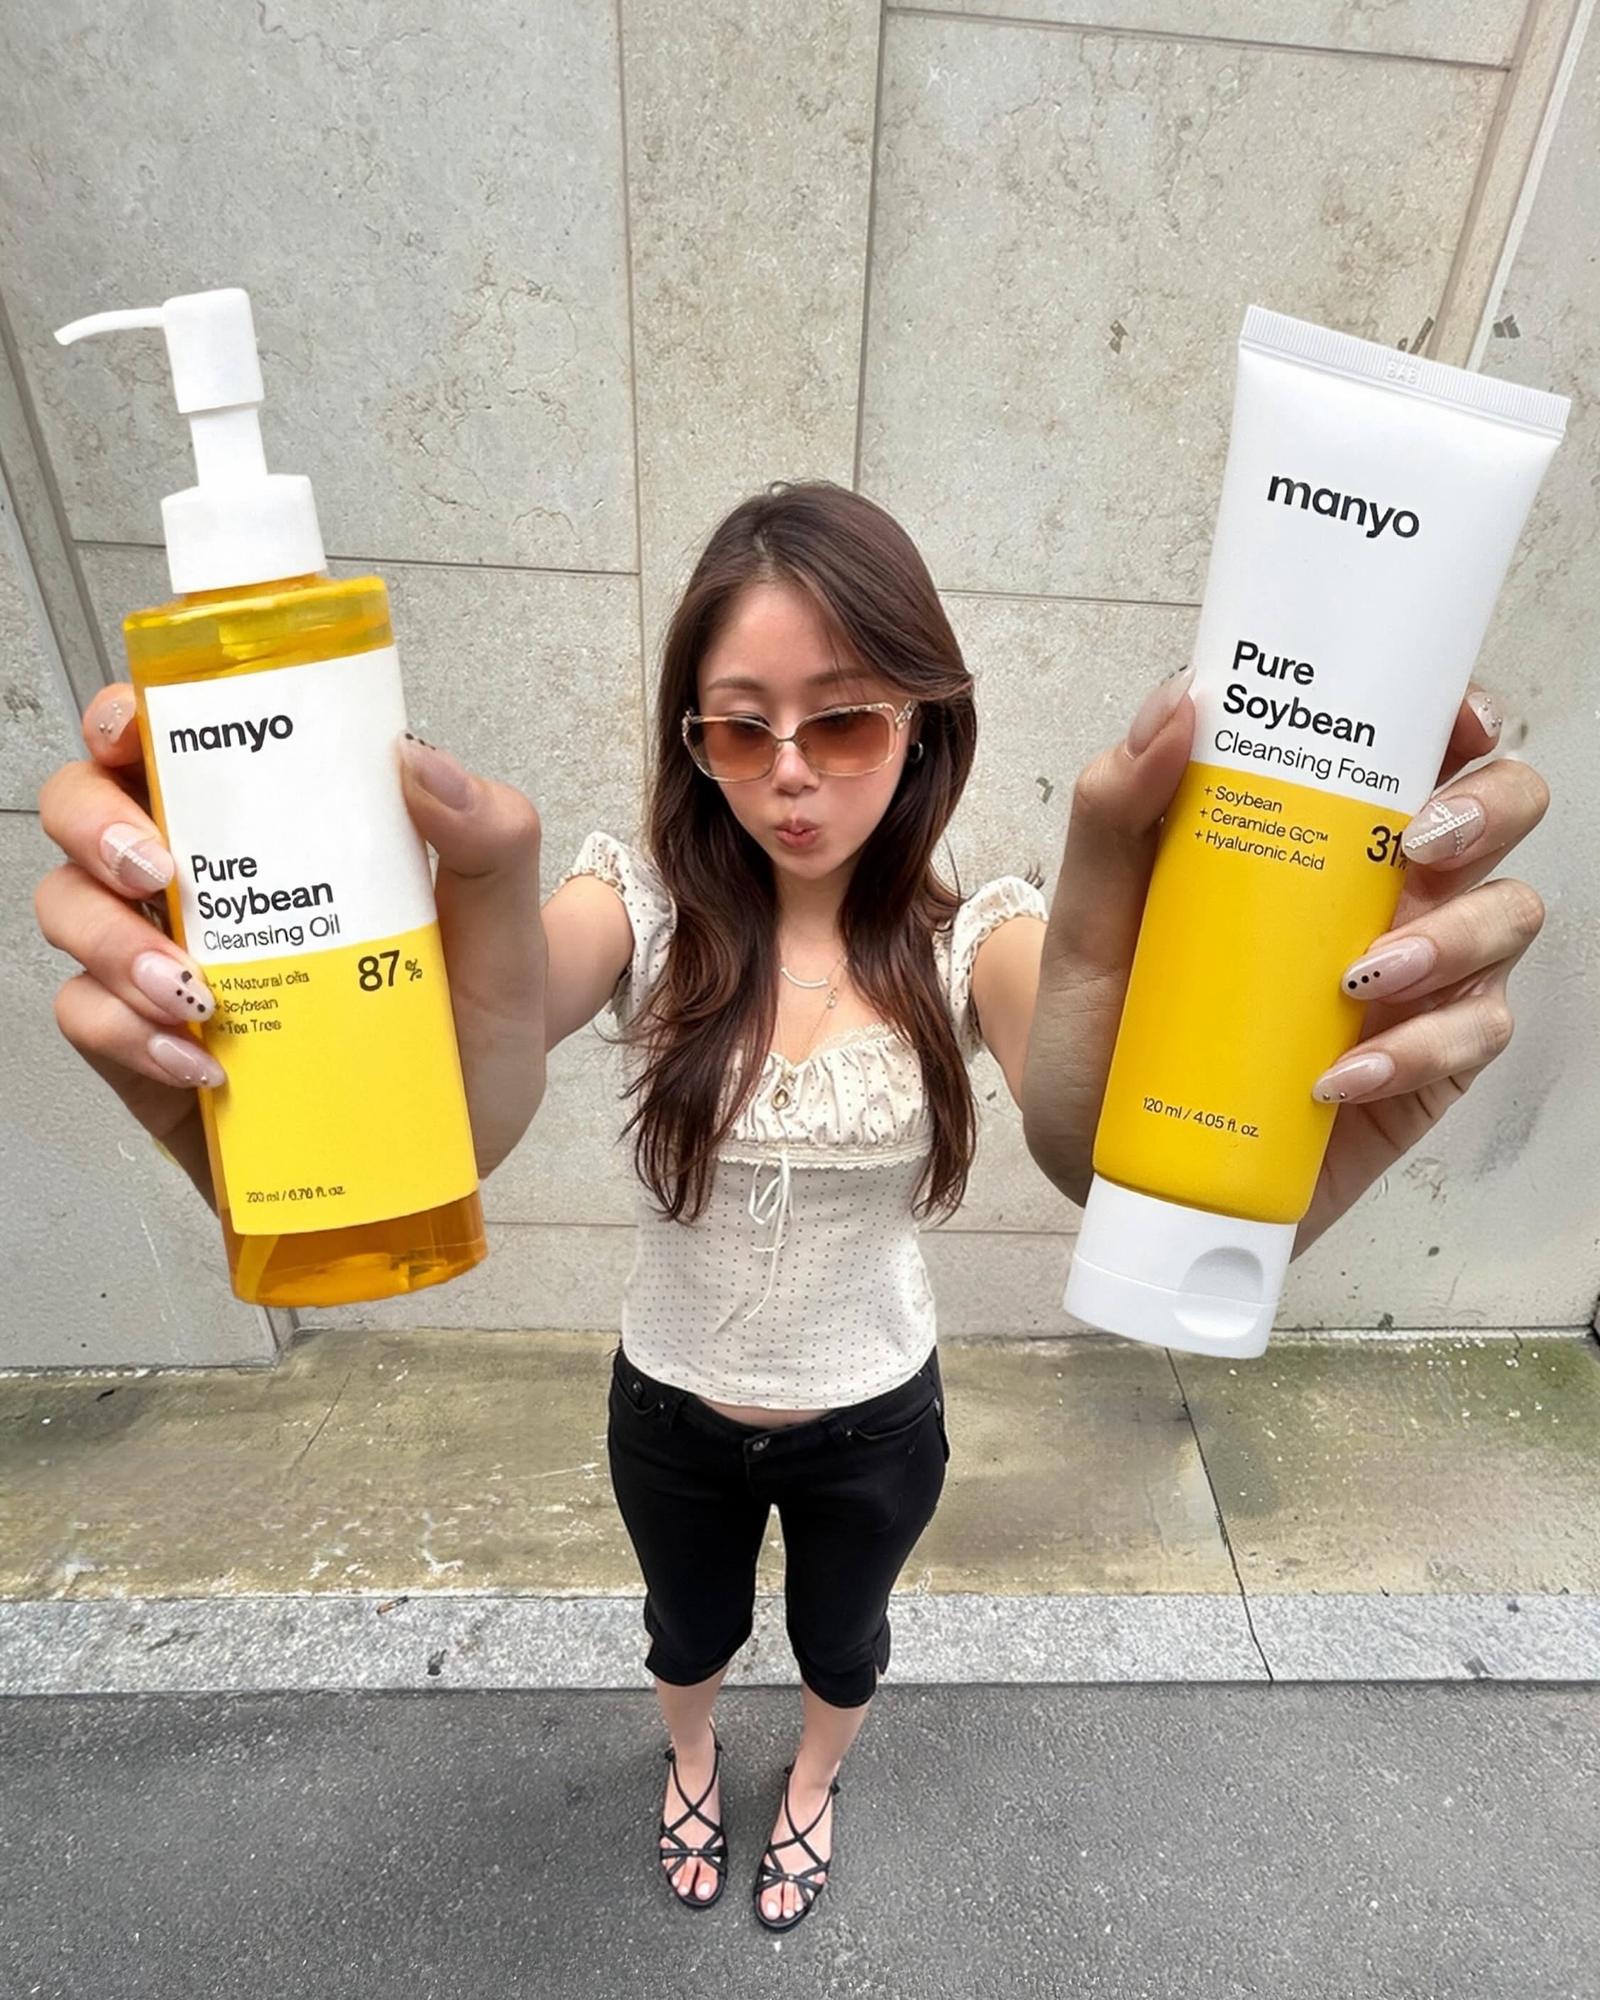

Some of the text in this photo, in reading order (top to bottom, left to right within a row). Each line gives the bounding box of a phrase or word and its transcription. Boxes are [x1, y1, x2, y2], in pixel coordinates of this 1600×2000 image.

[1267, 475, 1420, 539] manyo
[1232, 640, 1315, 685] Pure
[1223, 683, 1375, 747] Soybean
[169, 714, 293, 753] manyo
[1214, 729, 1400, 794] Cleansing Foam
[1215, 785, 1283, 814] Soybean
[1211, 808, 1287, 838] Ceramide
[1205, 829, 1287, 861] Hyaluronic
[1289, 850, 1326, 870] Acid
[191, 854, 258, 883] Pure
[197, 882, 334, 924] Soybean
[203, 914, 341, 951] Cleansing Oil
[233, 973, 283, 990] Natural
[223, 999, 279, 1015] Soybean
[225, 1020, 248, 1034] Tea
[250, 1018, 282, 1032] Tree
[1143, 1096, 1163, 1113] 120
[1164, 1104, 1182, 1119] ml
[1183, 1108, 1192, 1121] /
[1193, 1111, 1225, 1129] 4.05
[266, 1190, 280, 1202] ml
